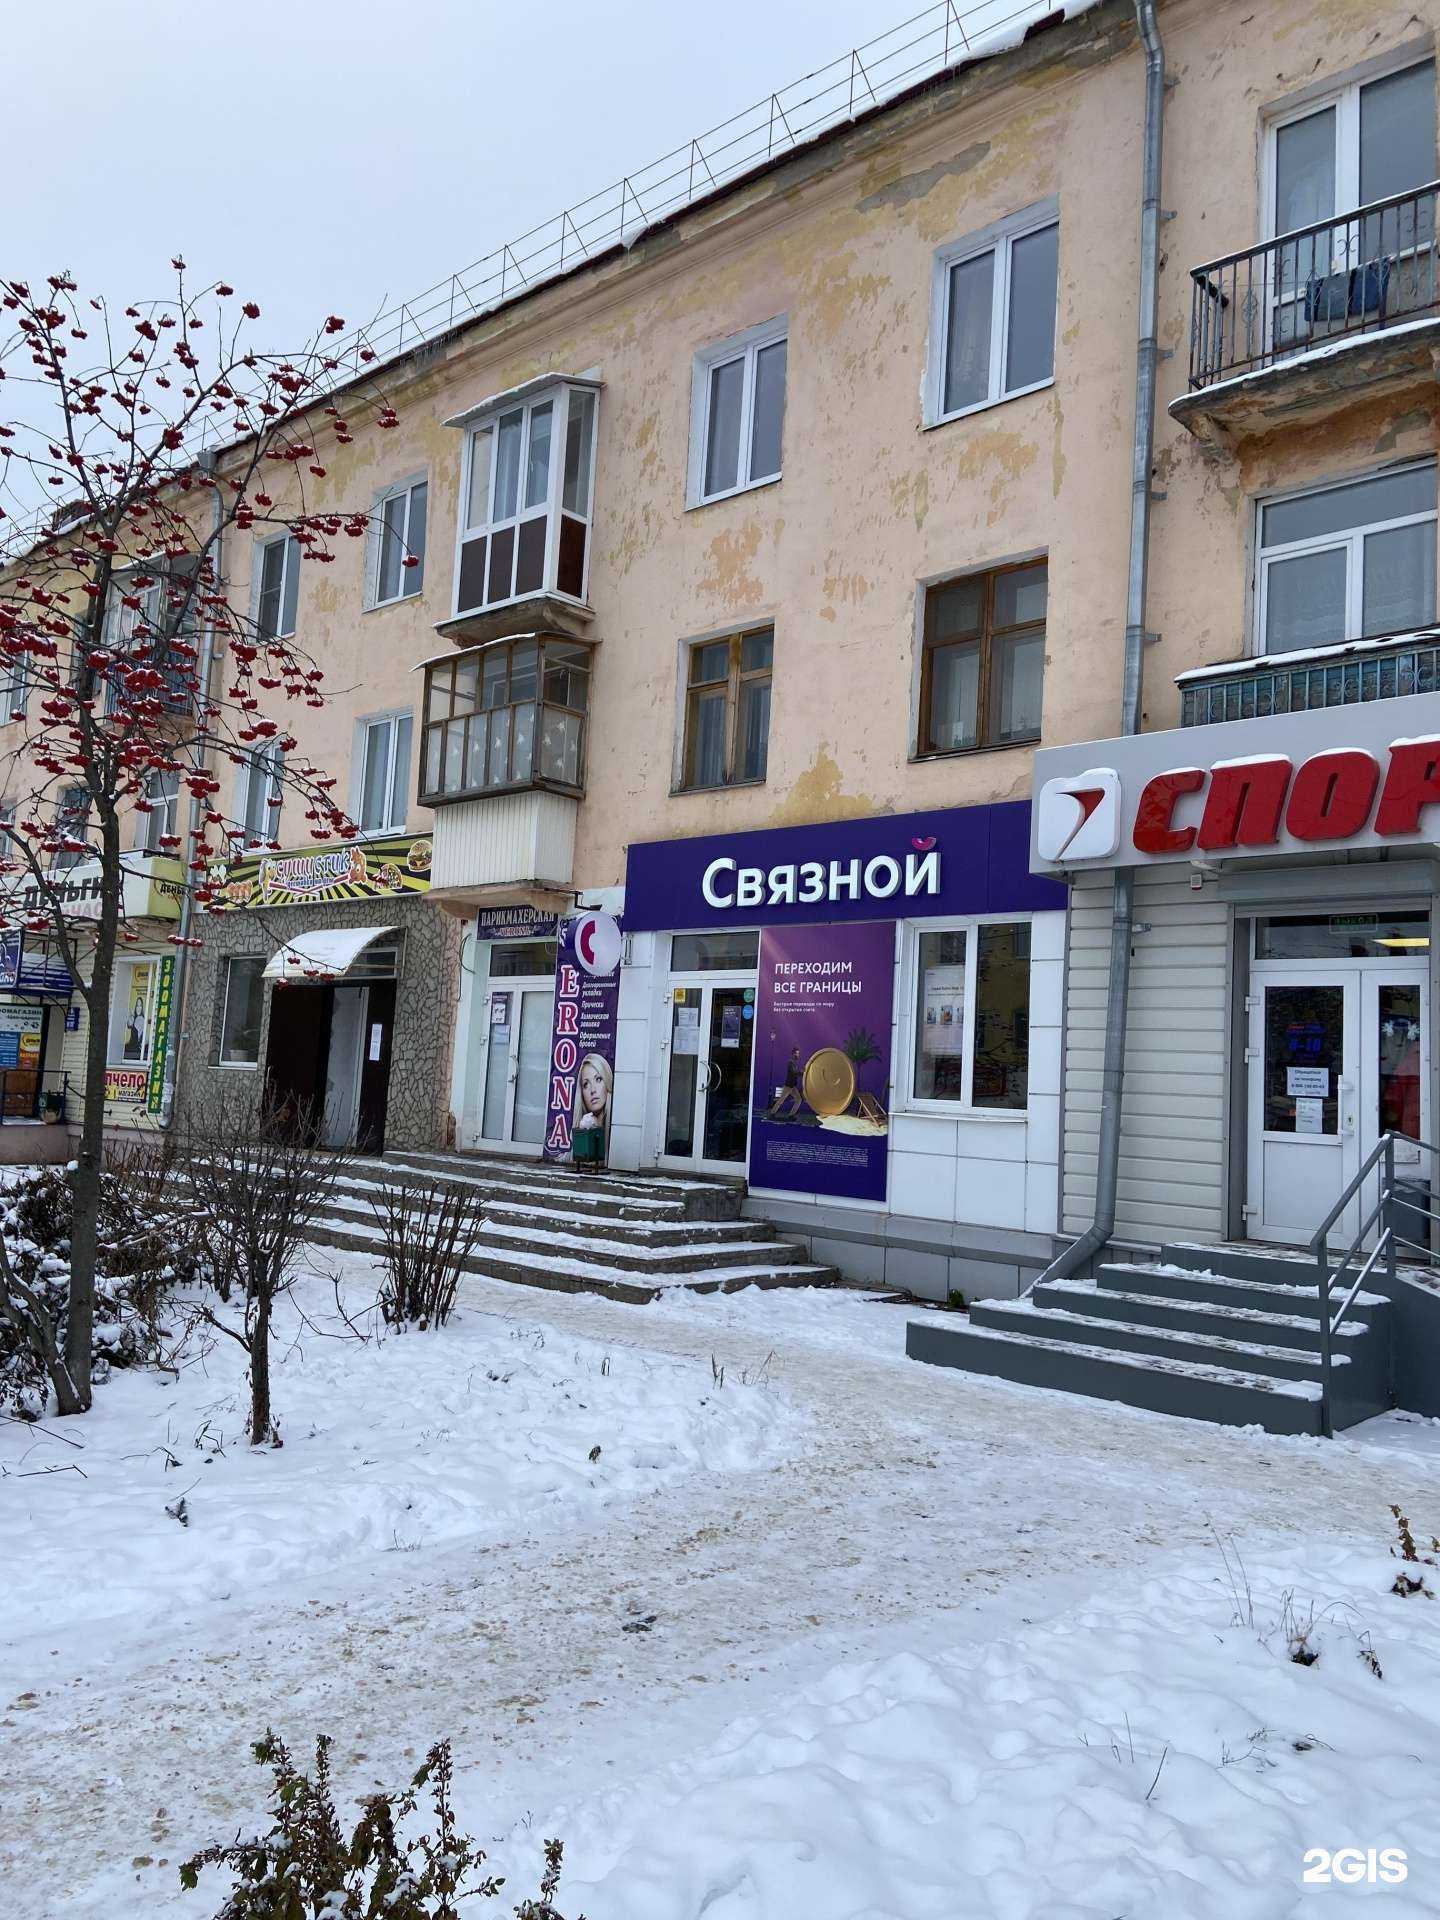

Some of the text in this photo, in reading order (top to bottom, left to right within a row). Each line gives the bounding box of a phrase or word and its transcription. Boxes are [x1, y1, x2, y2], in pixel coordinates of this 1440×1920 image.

[775, 962, 852, 975] ПЕРЕХОДИМ
[774, 980, 862, 995] ВСЕ ГРАНИЦЫ
[547, 928, 580, 1149] ERONA
